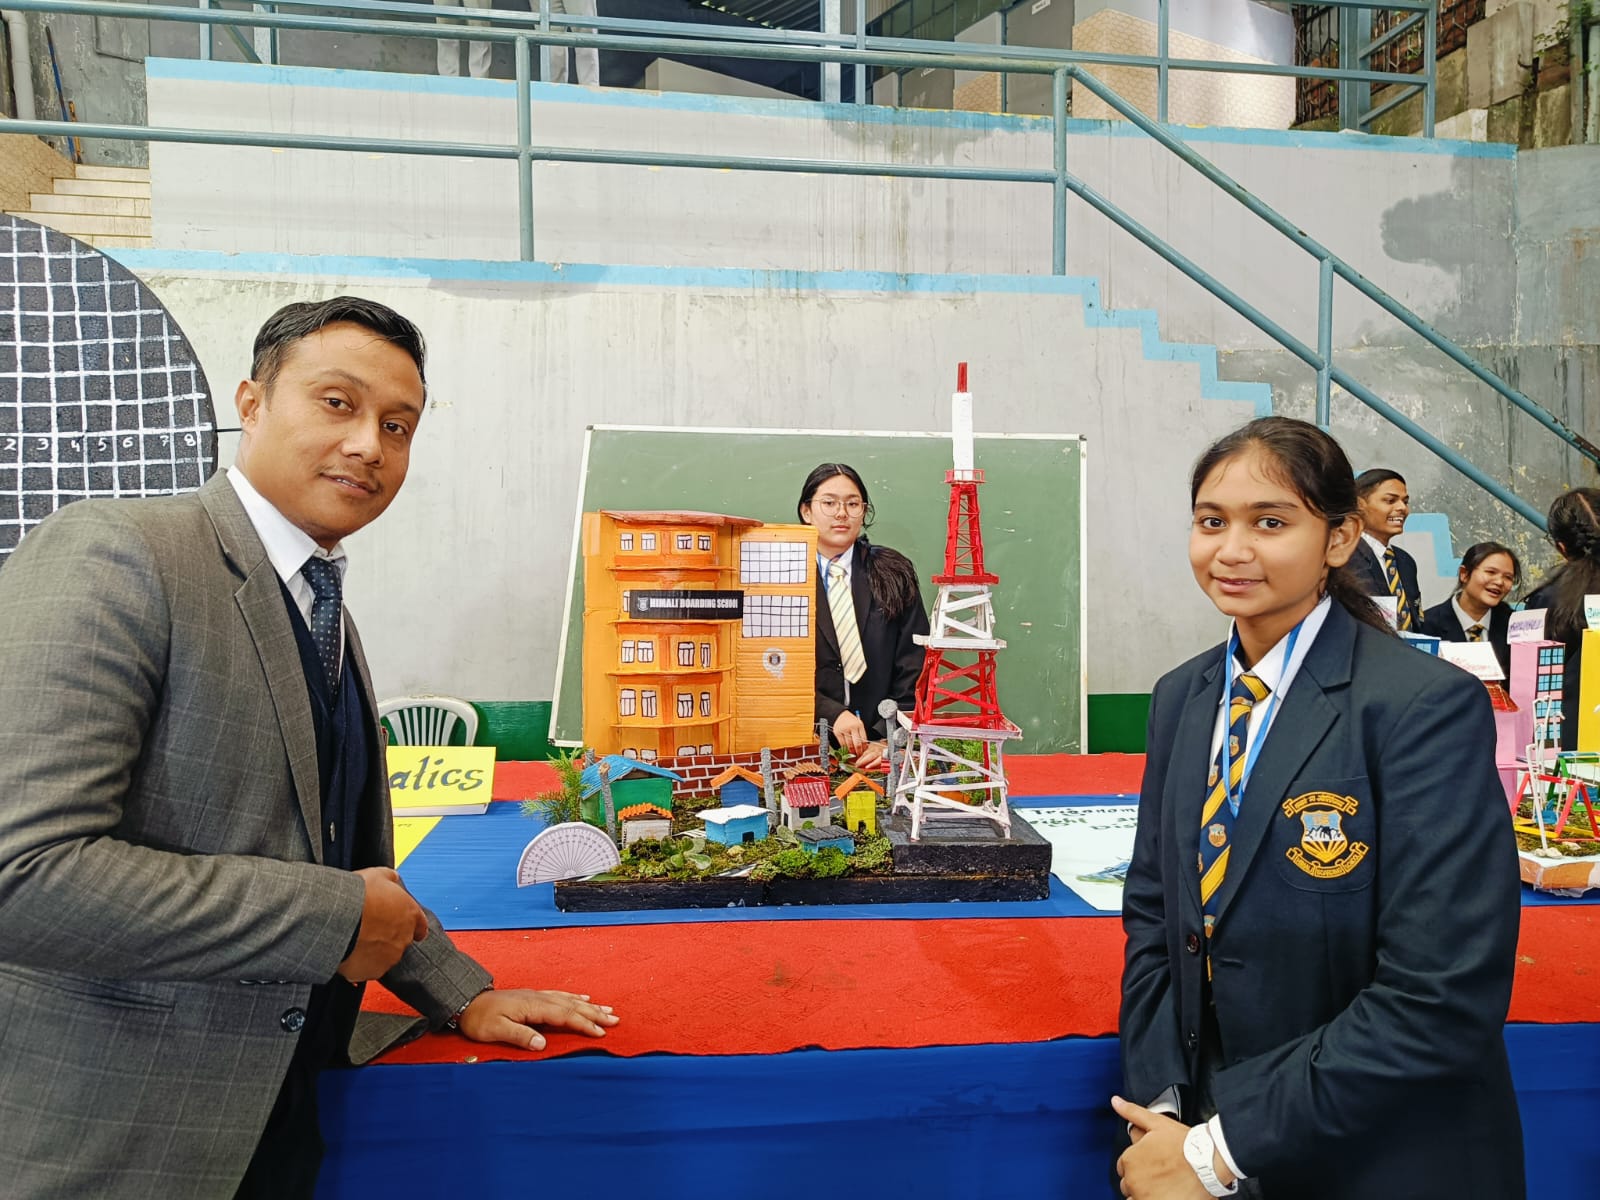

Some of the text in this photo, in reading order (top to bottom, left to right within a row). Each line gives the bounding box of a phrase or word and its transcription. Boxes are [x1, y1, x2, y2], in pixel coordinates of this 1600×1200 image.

[4, 433, 197, 452] 2 3 4 5 6 7 8
[679, 598, 716, 609] BOARDING
[716, 598, 738, 609] SCHOOL
[388, 755, 485, 791] alics
[1031, 807, 1136, 817] Trigonom
